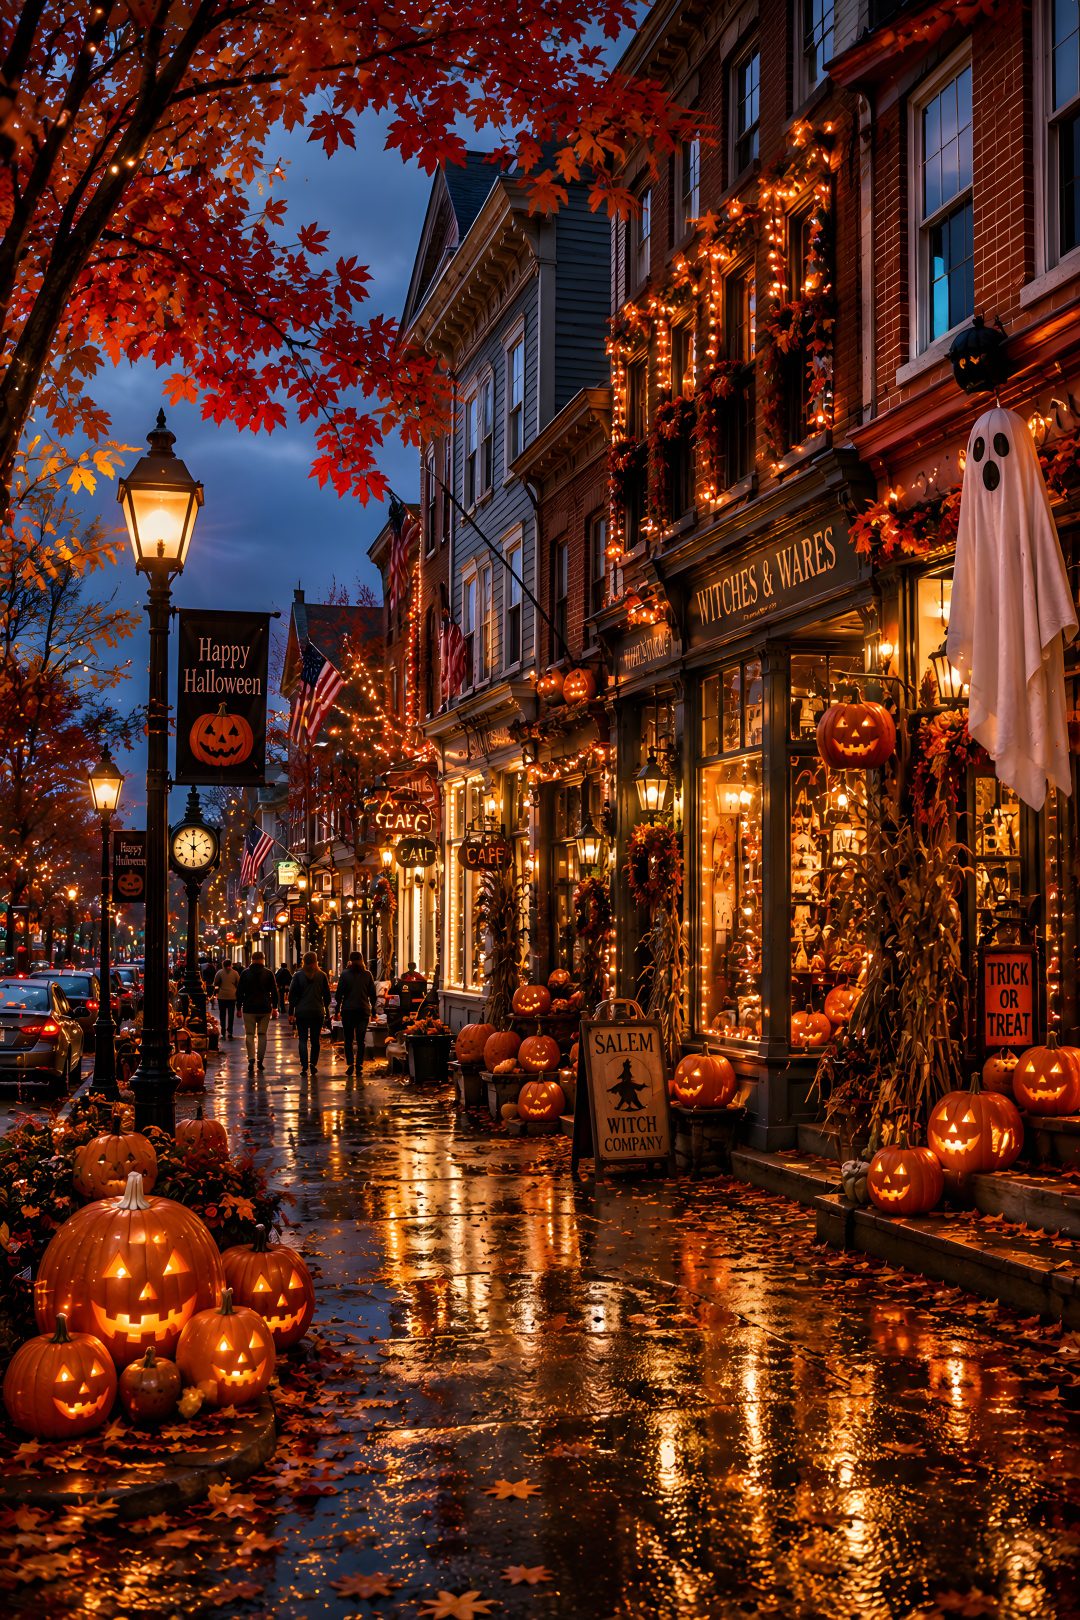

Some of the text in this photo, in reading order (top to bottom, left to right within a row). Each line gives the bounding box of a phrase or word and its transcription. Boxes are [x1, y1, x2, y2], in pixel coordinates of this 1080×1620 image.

[696, 526, 836, 626] WITCHES & WARES
[198, 637, 250, 669] Happy
[183, 668, 262, 695] Halloween
[987, 962, 1029, 986] TRICK
[999, 989, 1019, 1009] OR
[987, 1012, 1030, 1037] TREAT
[595, 1032, 654, 1054] SALEM
[607, 1116, 657, 1134] WITCH
[604, 1136, 664, 1152] COMPANY
